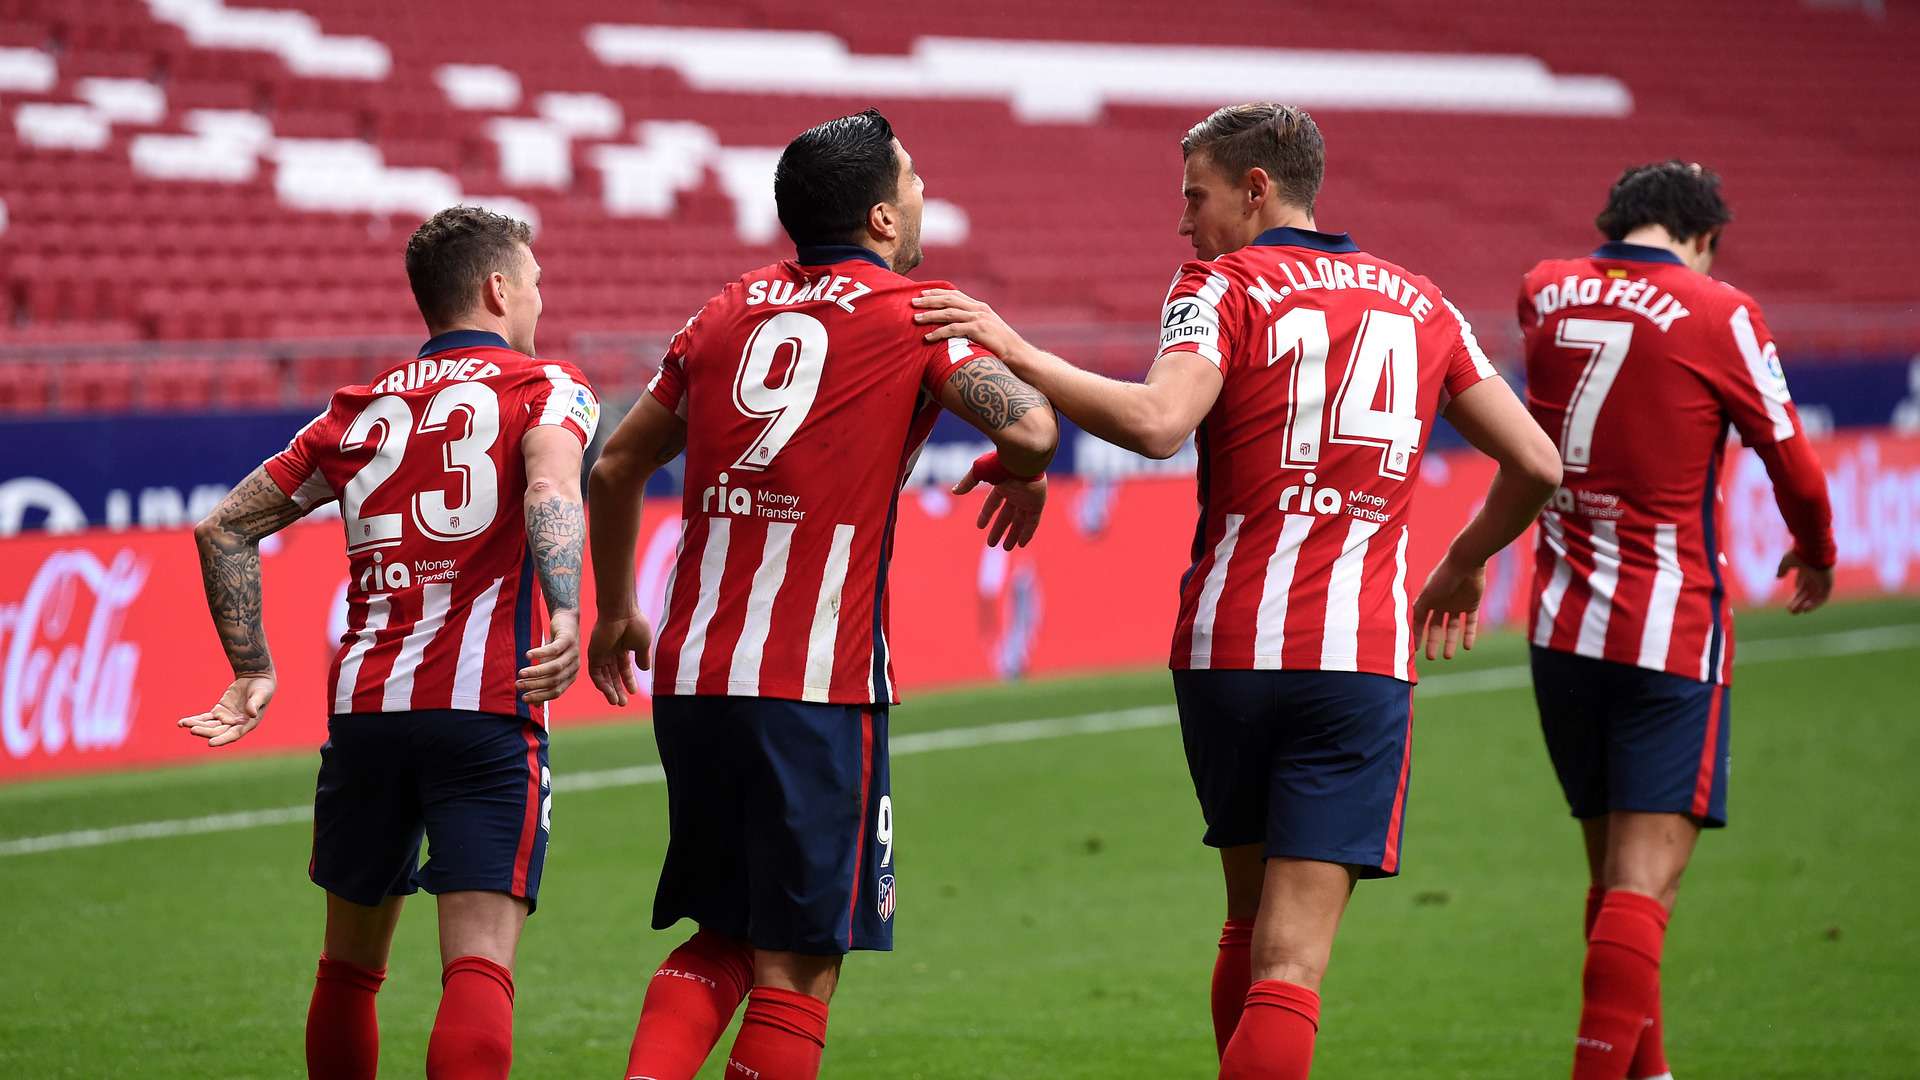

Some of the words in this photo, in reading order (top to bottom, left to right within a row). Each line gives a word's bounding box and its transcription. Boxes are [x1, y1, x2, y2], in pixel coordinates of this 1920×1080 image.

[1604, 278, 1690, 333] FÉLIX
[1160, 325, 1209, 348] YUNDAI
[730, 311, 829, 472] 9
[1267, 307, 1422, 481] 14
[1555, 317, 1634, 473] 7
[340, 381, 500, 556] 23
[702, 472, 751, 515] ria
[757, 489, 800, 508] Money
[1278, 472, 1342, 514] ria
[1348, 490, 1388, 508] Money
[1578, 488, 1619, 508] Money
[756, 505, 806, 521] Transfer
[1345, 504, 1390, 522] Transfer
[1578, 503, 1624, 519] Transfer
[360, 551, 410, 592] ria
[415, 557, 456, 574] Money
[415, 568, 460, 585] Transfer
[877, 795, 893, 868] 9
[654, 968, 716, 989] ATLETI
[728, 1058, 760, 1080] LETI
